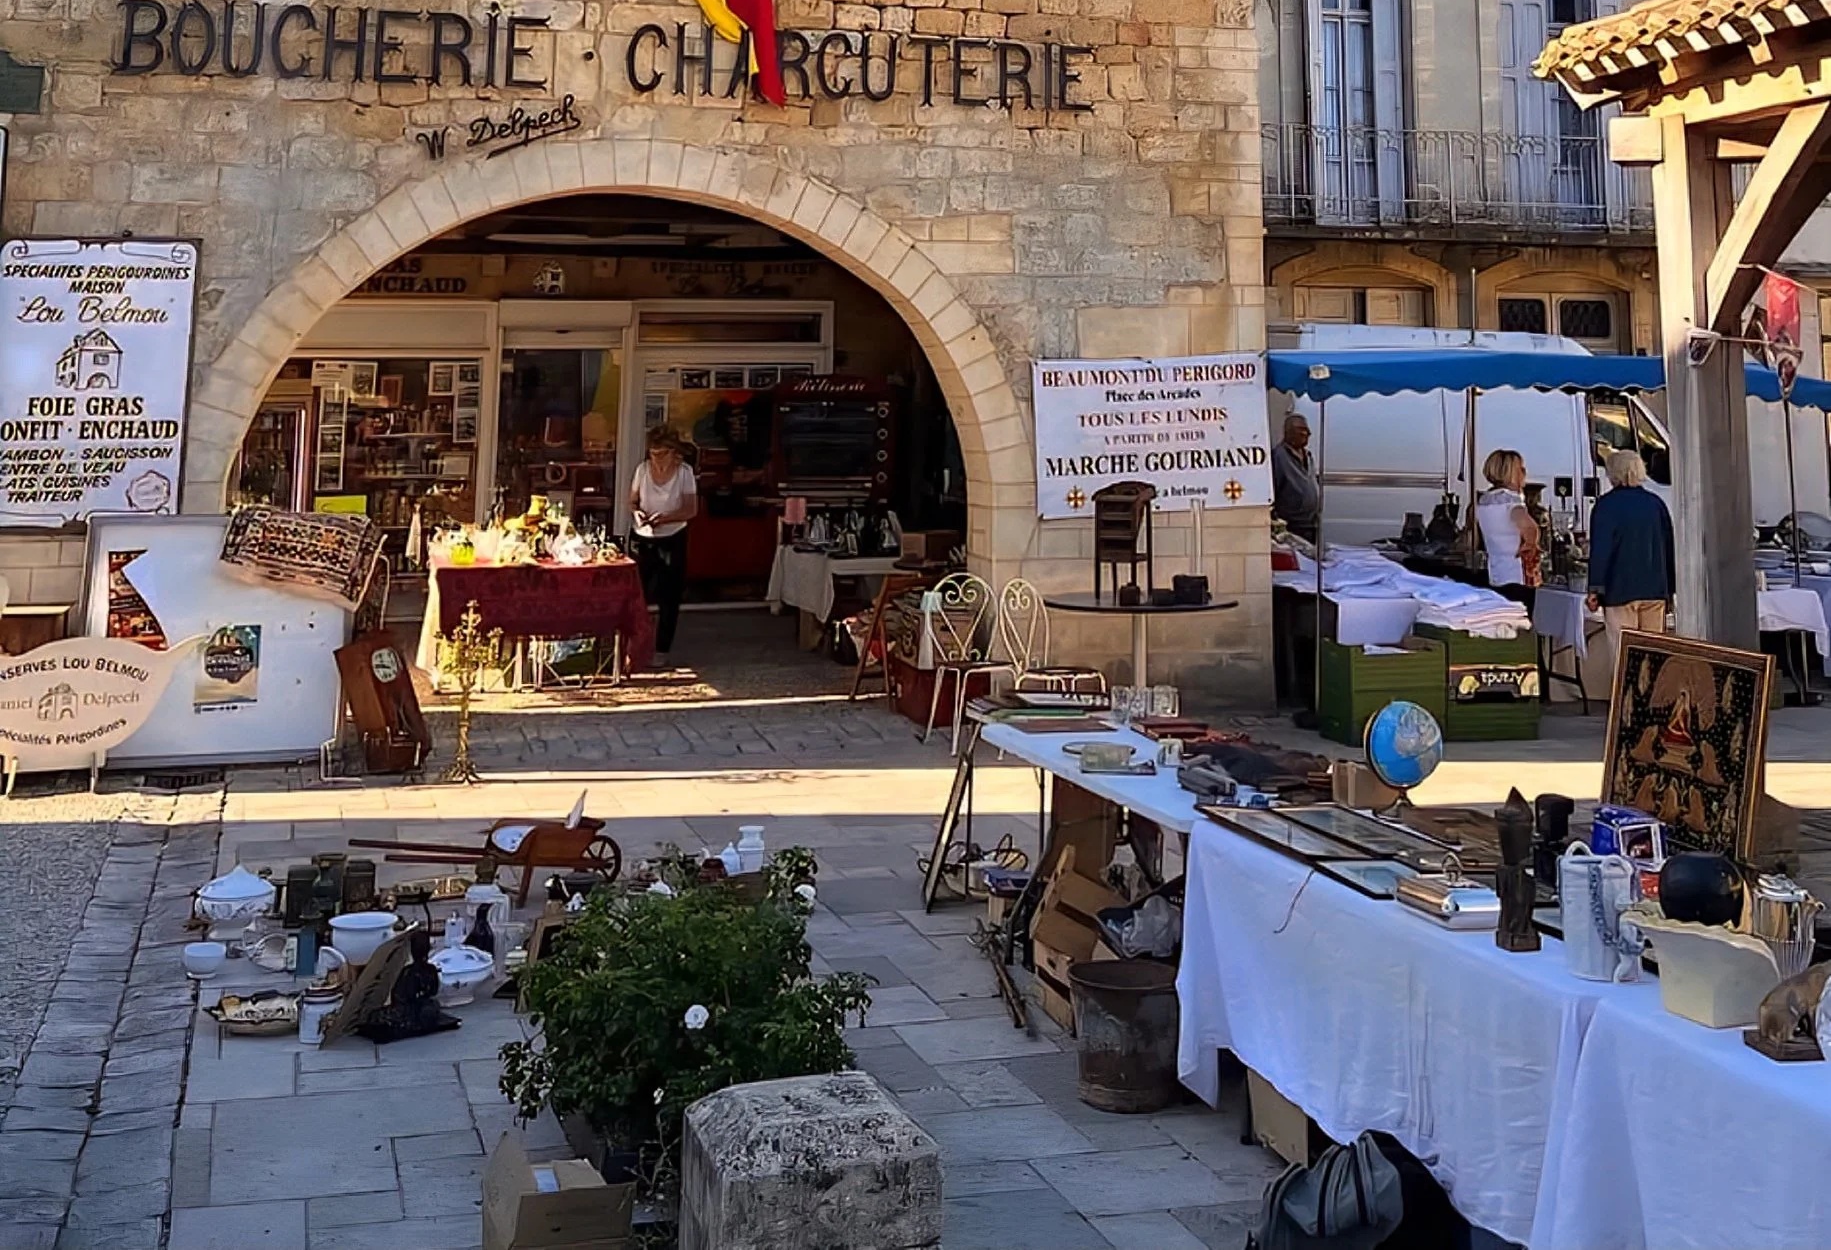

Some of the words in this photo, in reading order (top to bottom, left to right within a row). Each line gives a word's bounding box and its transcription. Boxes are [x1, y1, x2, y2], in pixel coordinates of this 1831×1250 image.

[415, 131, 447, 160] W
[87, 265, 191, 280] PERIGOURDINES
[68, 281, 126, 294] MAISON
[362, 276, 467, 293] NCHAUD
[1173, 363, 1256, 382] PERIGORD
[1105, 390, 1135, 403] Place
[1138, 390, 1155, 401] des
[1158, 387, 1201, 401] Arcades
[28, 397, 76, 417] FOIE
[86, 396, 144, 416] GRAS
[1078, 412, 1124, 428] TOUS
[1129, 410, 1161, 425] LES
[1166, 406, 1229, 424] LUNDIS
[0, 420, 63, 441] ONFIT
[78, 420, 179, 440] ENCHAUD
[0, 448, 64, 461] AMBON
[81, 446, 173, 460] SAUCISSON
[1046, 452, 1138, 477] MARCHE
[1145, 446, 1266, 472] GOURMAND
[0, 463, 50, 475] ENTRE
[83, 462, 126, 474] VEAU
[7, 490, 83, 503] TRAITEUR
[63, 656, 90, 670] LOU
[95, 658, 149, 683] BELMOU
[0, 695, 33, 710] aniel
[83, 690, 140, 707] Delpech
